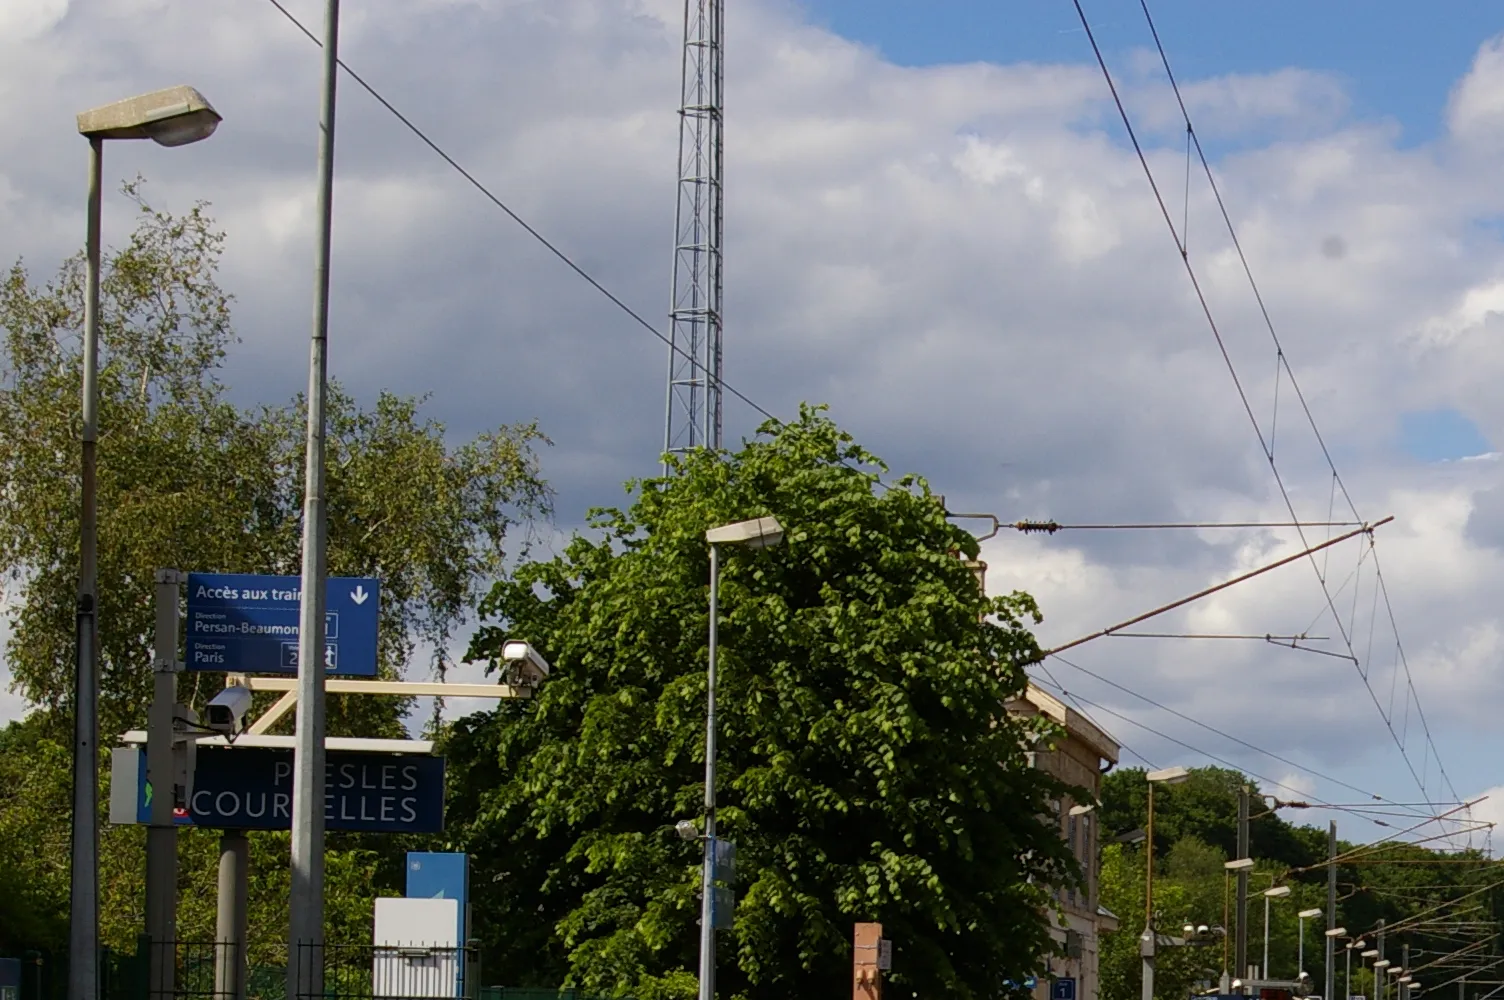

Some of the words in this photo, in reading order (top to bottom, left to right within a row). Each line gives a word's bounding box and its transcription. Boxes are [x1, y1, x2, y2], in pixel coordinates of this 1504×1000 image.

[196, 585, 238, 599] Accès
[242, 589, 268, 600] aux
[195, 621, 300, 635] Persan-Beaumon
[194, 651, 225, 663] Paris
[274, 761, 418, 791] PESLES
[191, 790, 417, 823] COURELLES
[1060, 987, 1066, 998] 1
